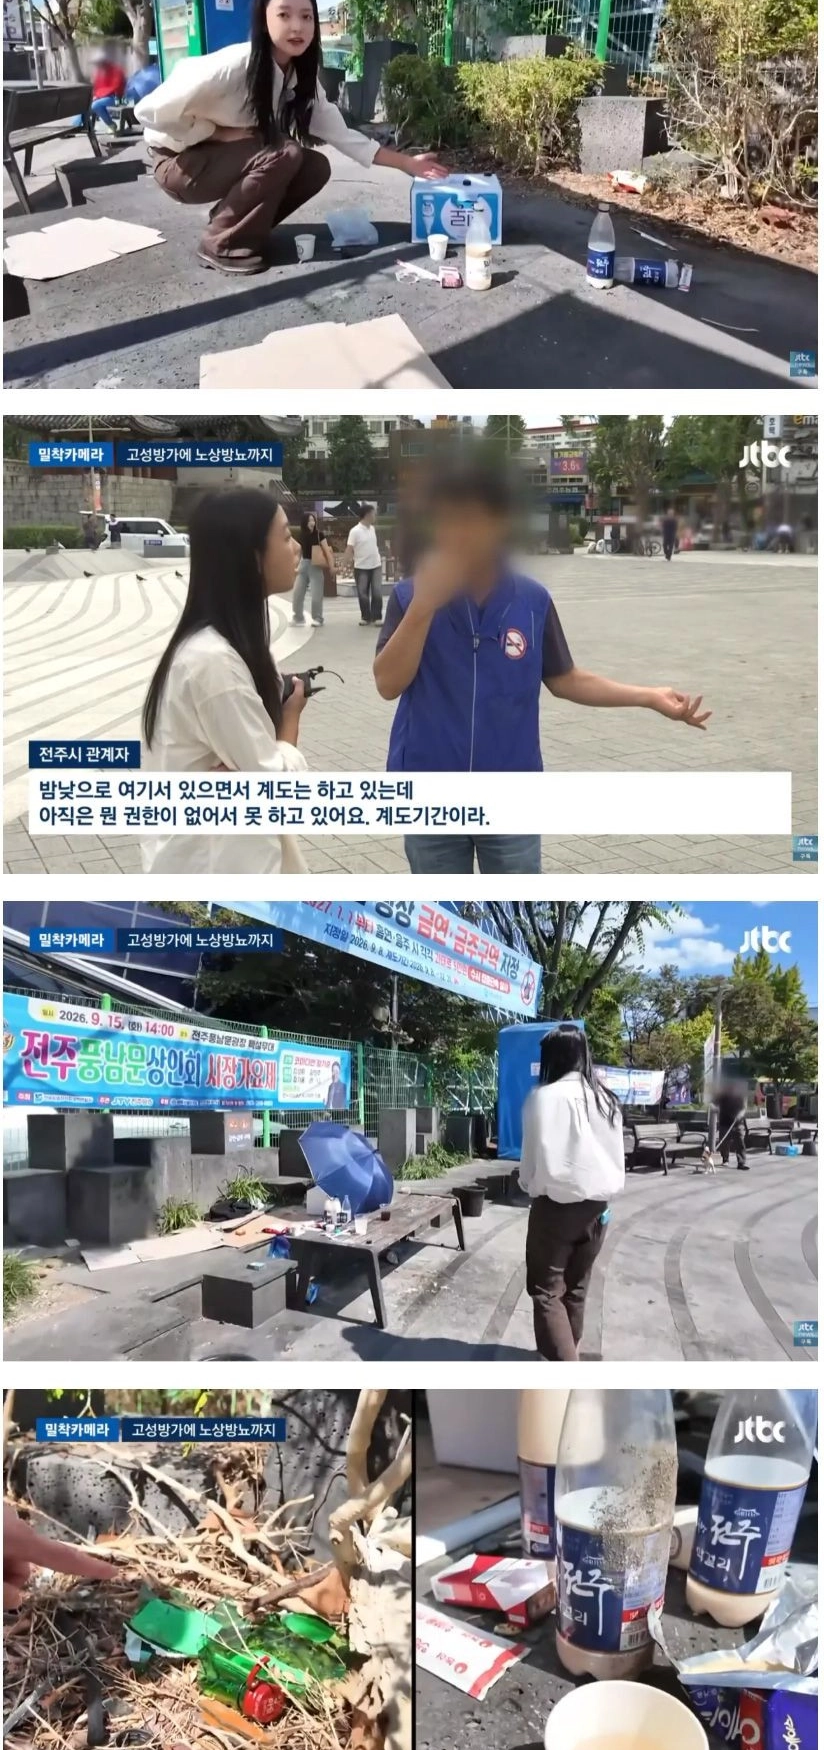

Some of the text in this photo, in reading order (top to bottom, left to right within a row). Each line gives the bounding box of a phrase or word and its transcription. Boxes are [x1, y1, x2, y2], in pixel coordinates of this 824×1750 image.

[59, 1009, 88, 1024] 2026.
[91, 1012, 103, 1026] 9.
[108, 1015, 125, 1029] 15.
[145, 1021, 175, 1037] 14:00
[205, 1052, 278, 1091] 시장가요제
